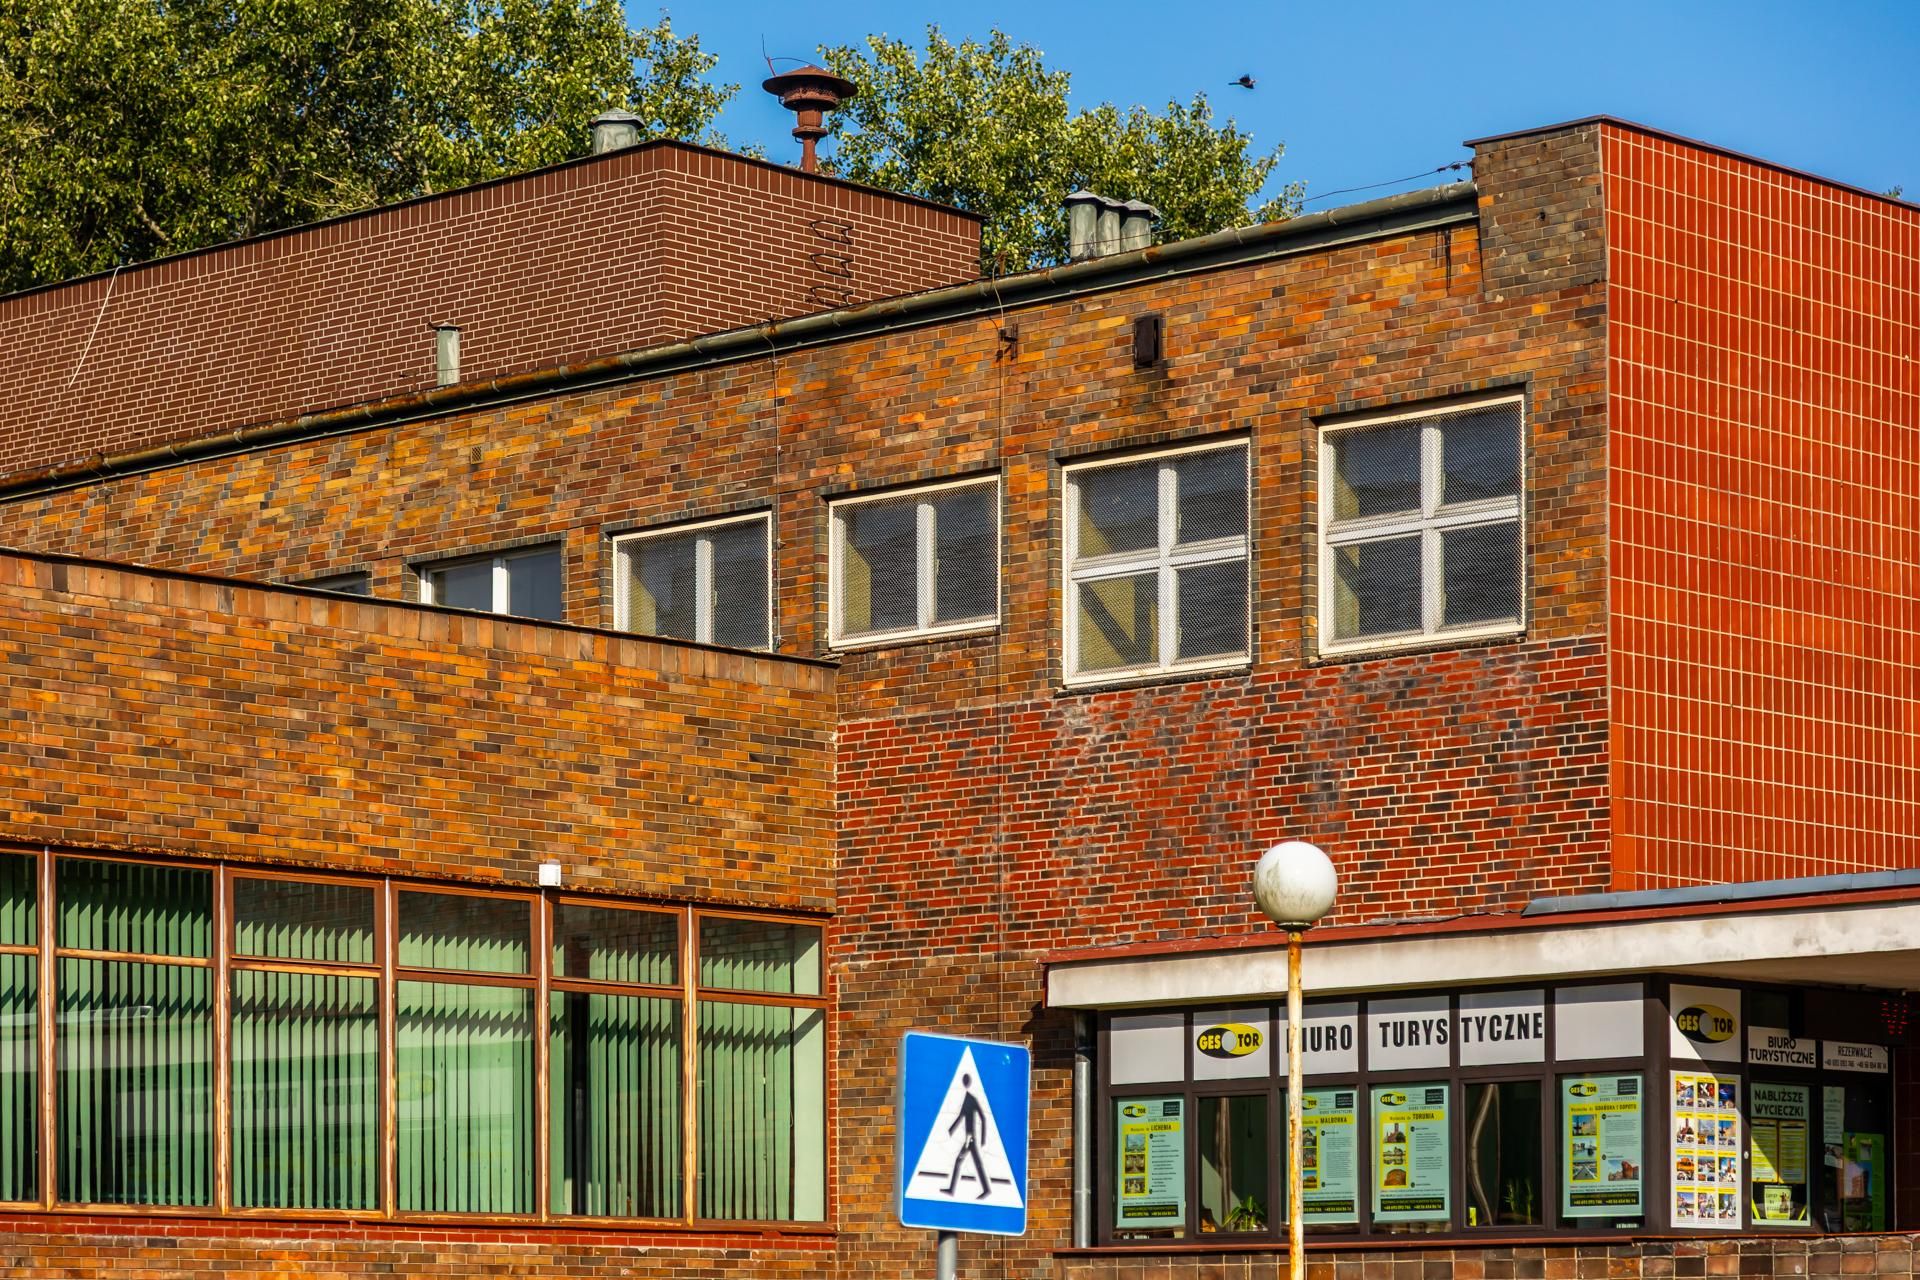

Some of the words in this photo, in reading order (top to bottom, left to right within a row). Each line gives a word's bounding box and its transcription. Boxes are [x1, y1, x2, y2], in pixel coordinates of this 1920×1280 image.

[1286, 1024, 1352, 1053] IURO
[1767, 1035, 1797, 1050] BIURO
[1749, 1047, 1815, 1065] TURYSTYCZNE
[1754, 1088, 1804, 1103] NABLIŻSZE
[1754, 1103, 1804, 1117] WYCIECZKI
